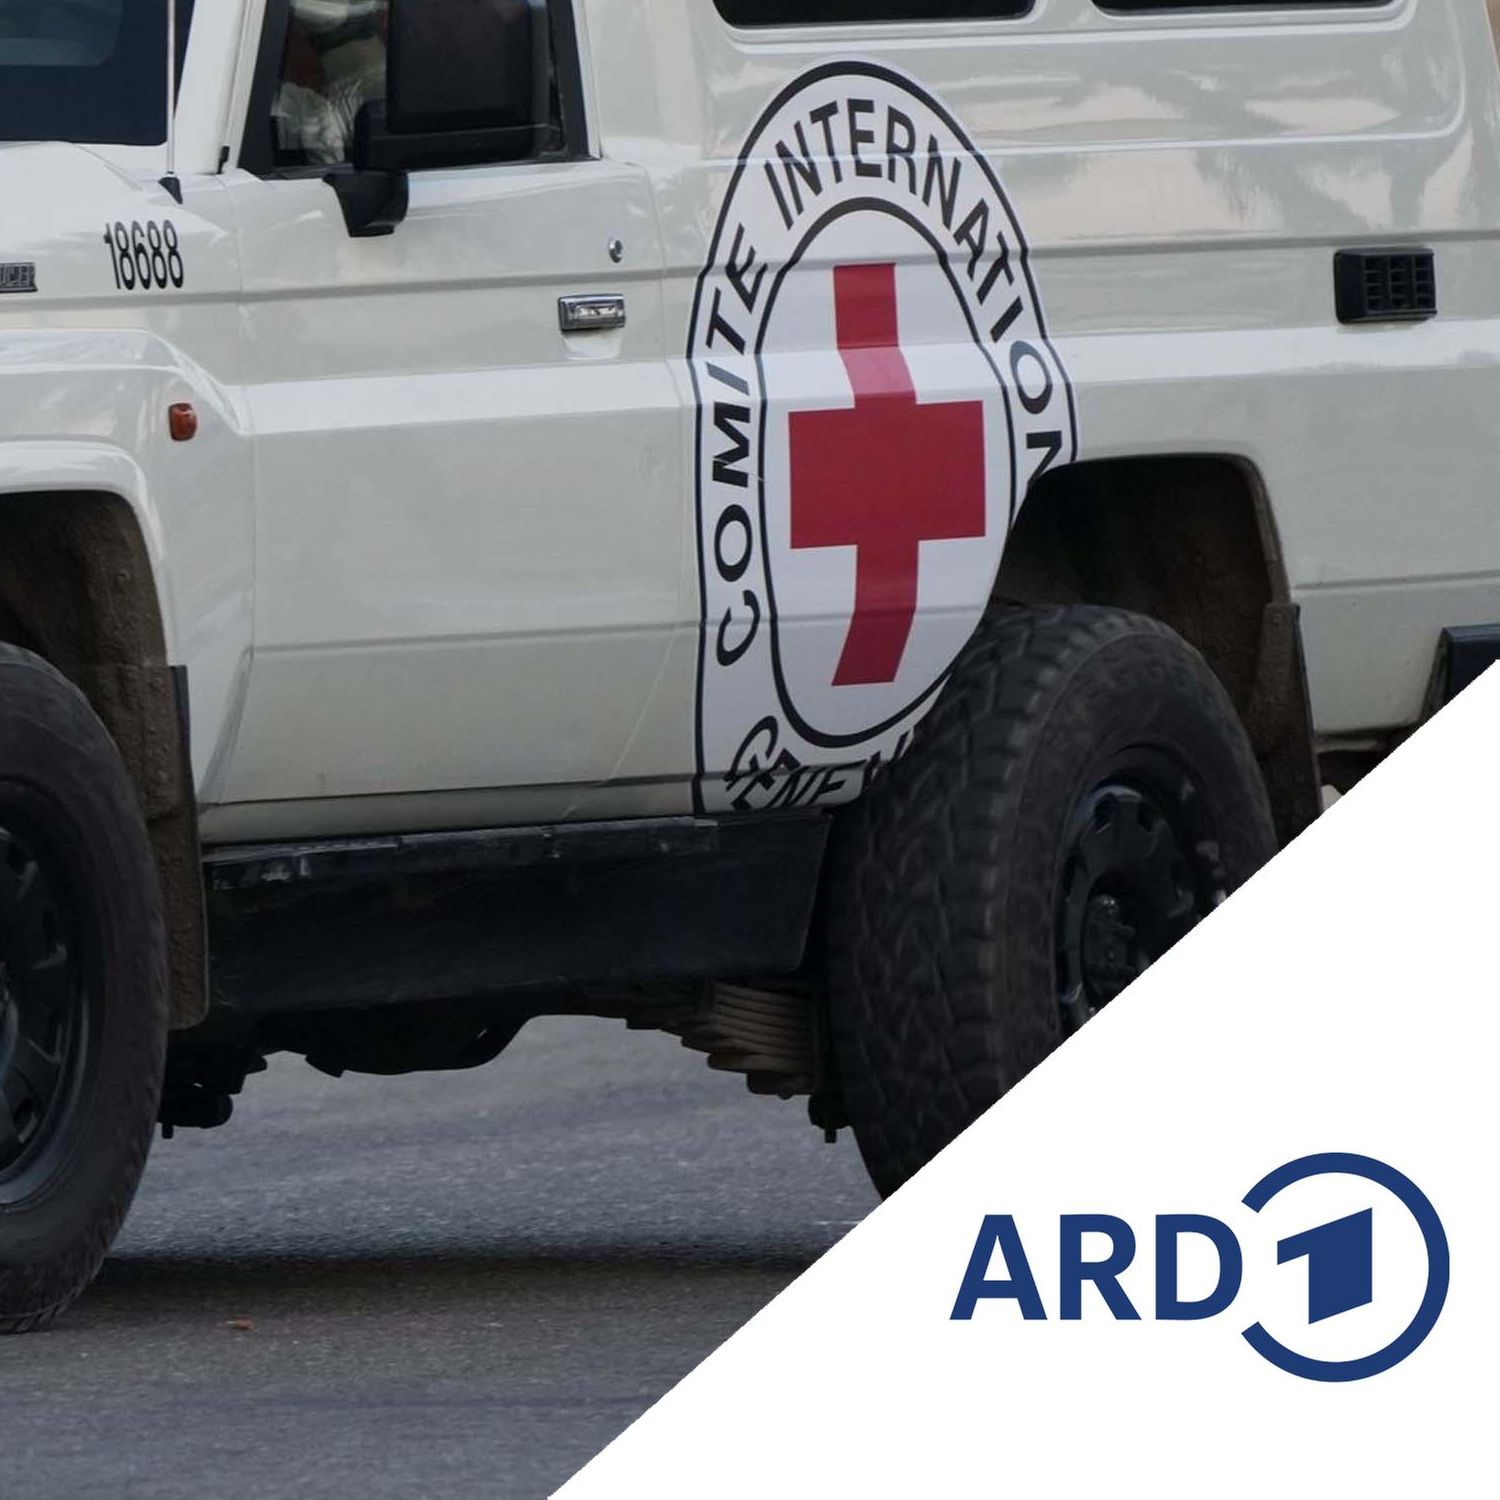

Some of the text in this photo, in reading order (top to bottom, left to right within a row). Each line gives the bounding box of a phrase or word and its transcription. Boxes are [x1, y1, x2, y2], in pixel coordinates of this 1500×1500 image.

[102, 219, 184, 290] 18688
[703, 96, 1062, 667] COMITE INTERNATION
